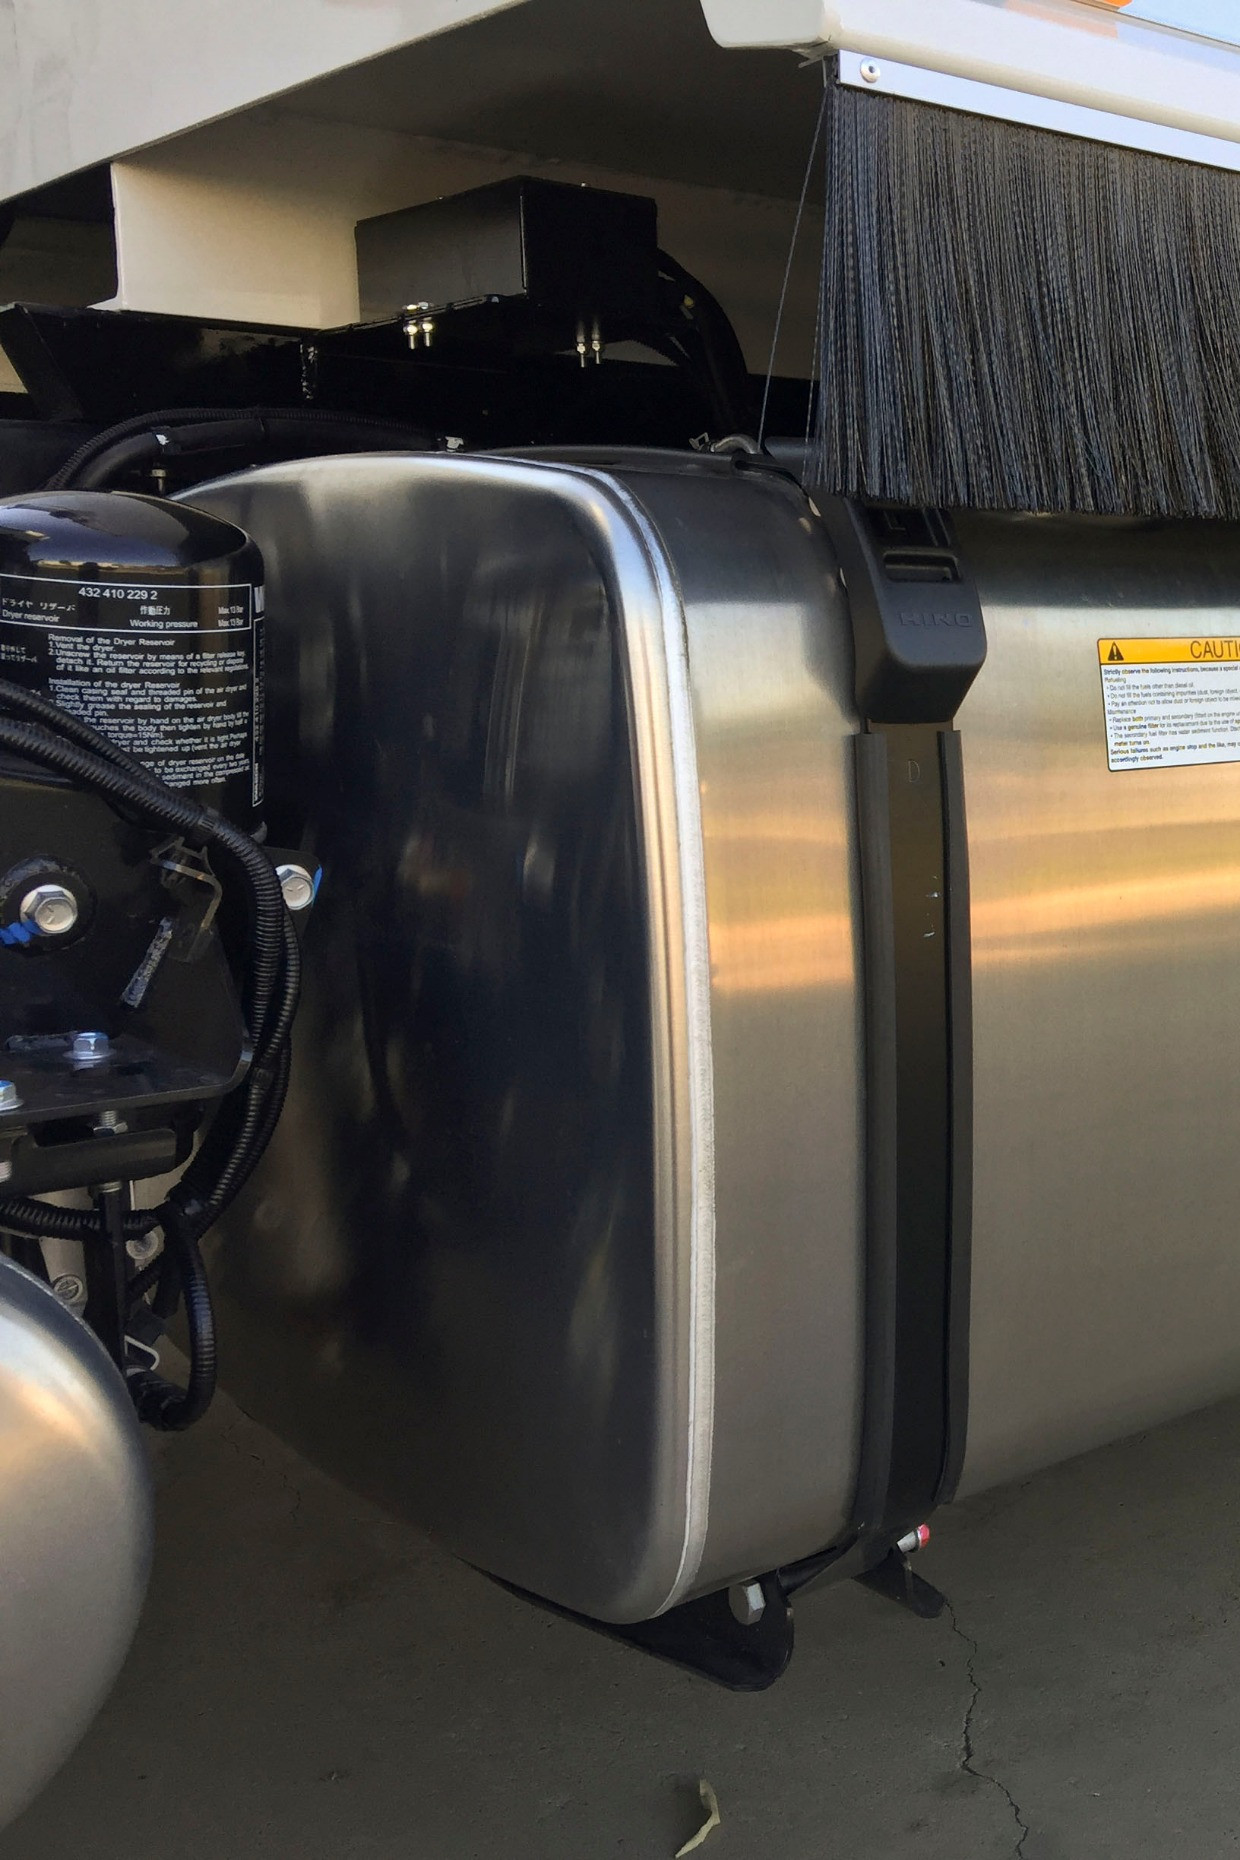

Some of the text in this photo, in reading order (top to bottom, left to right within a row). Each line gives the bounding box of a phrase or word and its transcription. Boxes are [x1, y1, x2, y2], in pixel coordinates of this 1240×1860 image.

[79, 587, 158, 600] 432 410 229 2
[3, 609, 60, 622] Dryer reservoir
[899, 611, 973, 628] HINO
[130, 619, 198, 630] Working pressure
[49, 634, 83, 643] Removal
[86, 636, 95, 644] of
[98, 637, 111, 645] the
[114, 638, 136, 647] Dryer
[77, 643, 90, 651] the
[94, 651, 107, 659] the
[110, 652, 145, 660] reservoir
[147, 653, 157, 661] by
[139, 667, 176, 676] according
[94, 680, 103, 688] of
[120, 681, 141, 690] dryer
[183, 688, 194, 697] pin
[100, 717, 135, 725] reservoir
[138, 718, 148, 726] by
[138, 725, 157, 733] body
